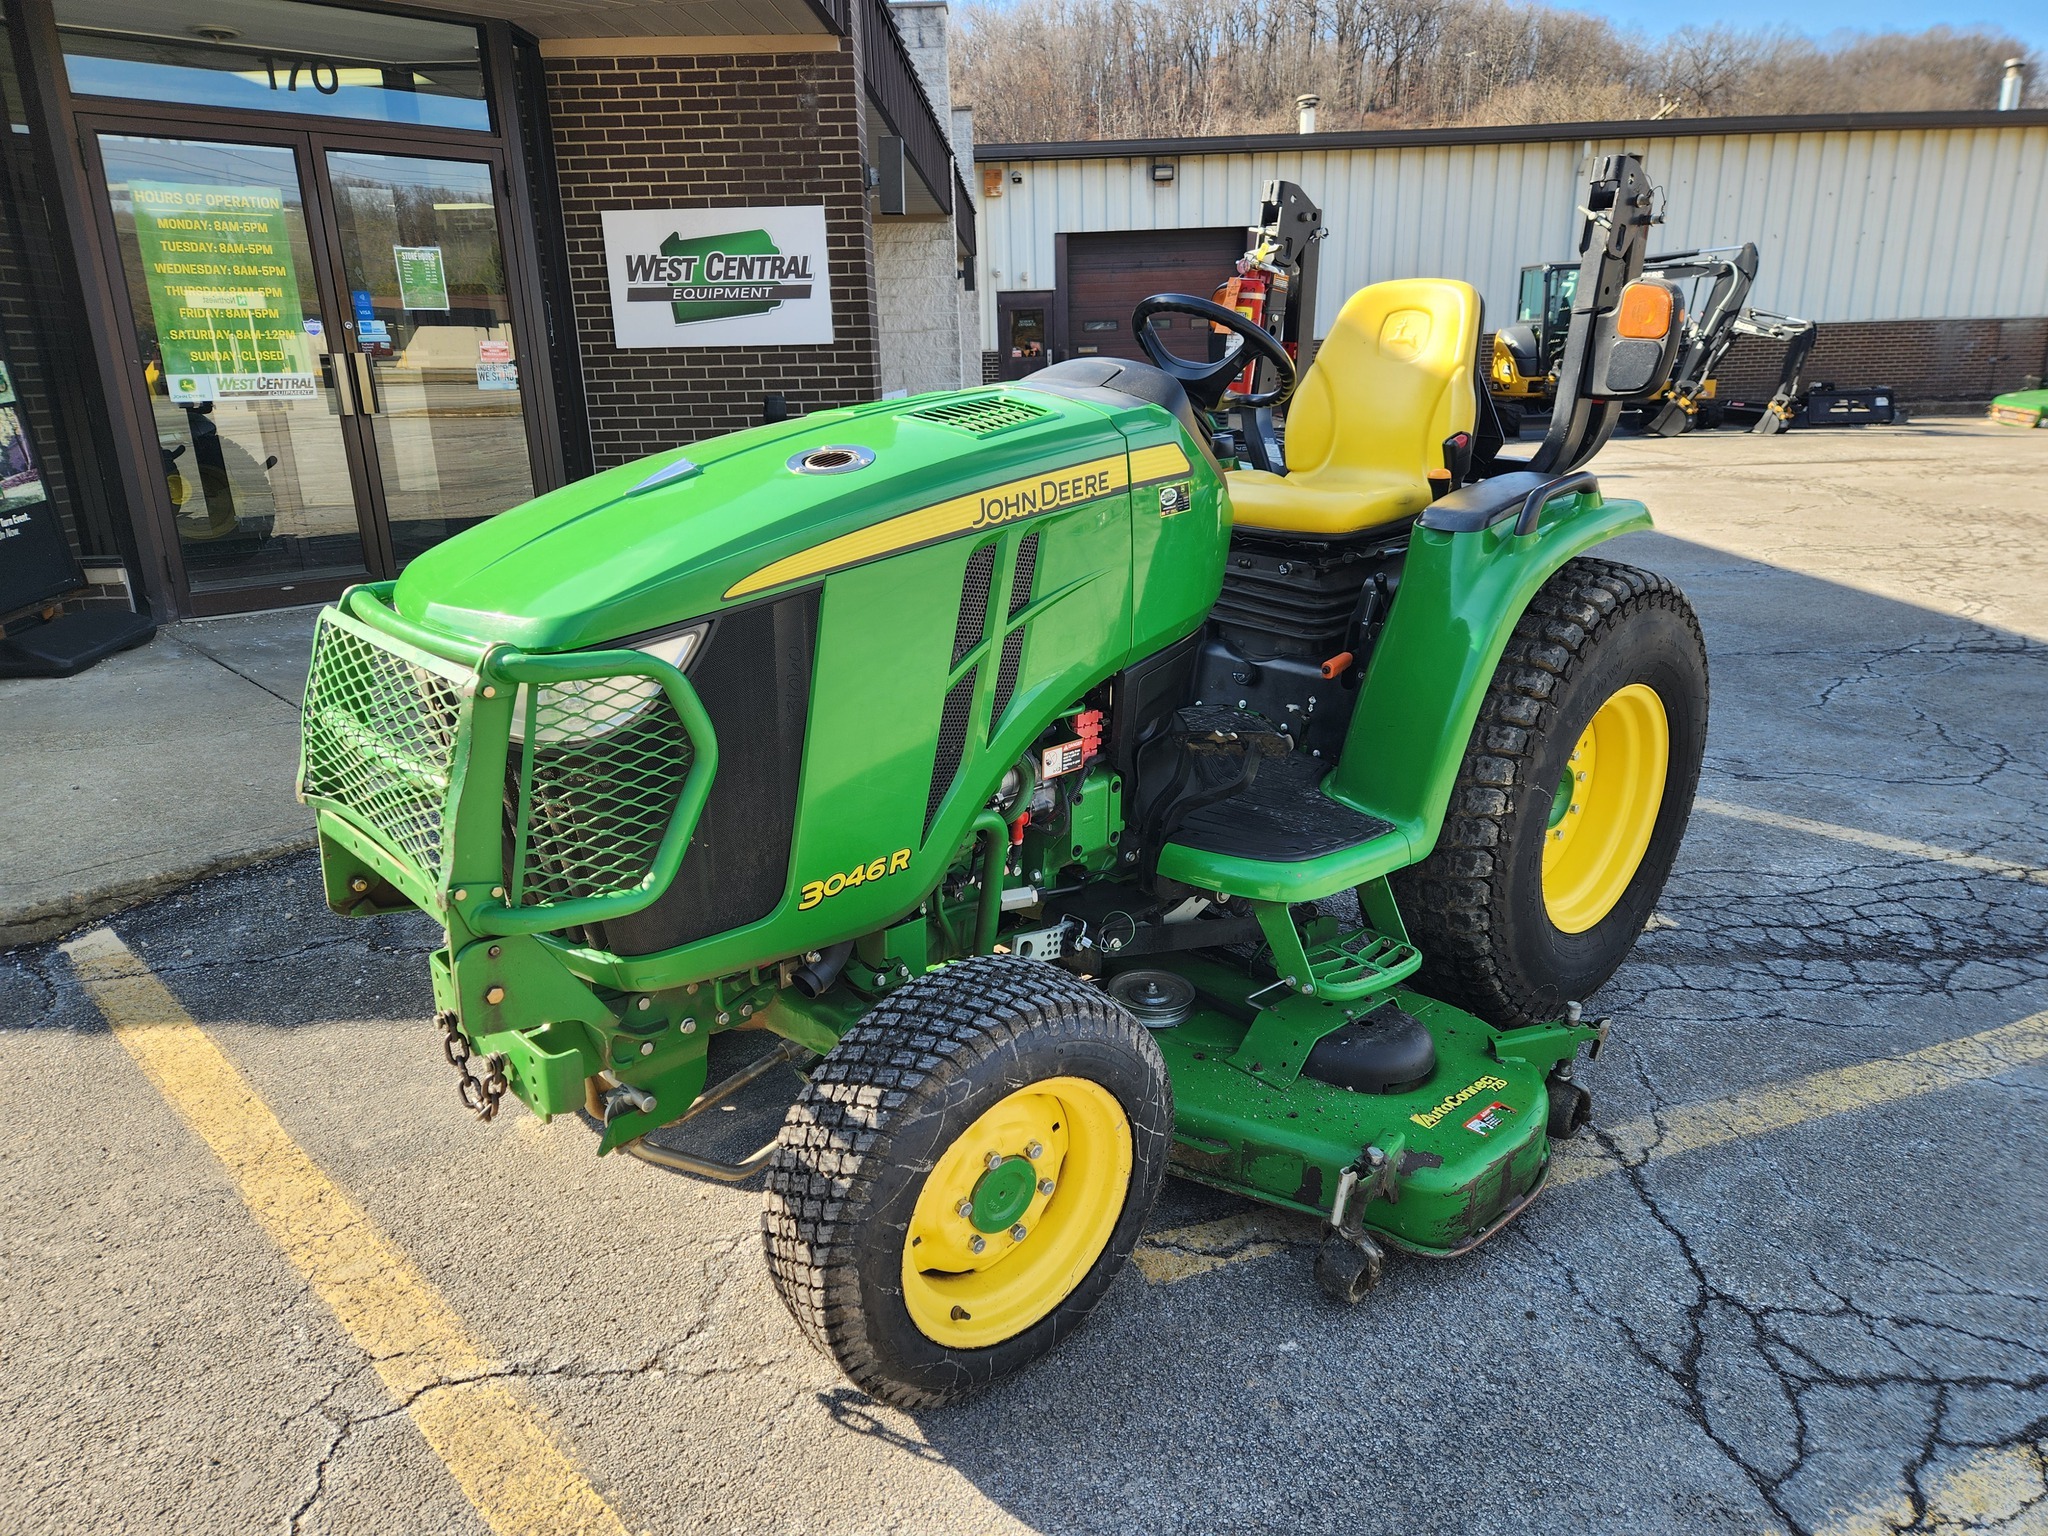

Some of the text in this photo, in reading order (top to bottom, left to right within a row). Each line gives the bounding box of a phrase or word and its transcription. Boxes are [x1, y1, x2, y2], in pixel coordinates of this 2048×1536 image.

[258, 56, 339, 94] 170
[133, 190, 280, 209] HOURS OF OPERATION
[157, 218, 268, 233] MONDAY: 8AM-5PM
[160, 240, 273, 255] TUESDAY: 8AM-5PM
[154, 263, 286, 277] WEDNESDAY: 8AM-5PM
[625, 252, 813, 282] WEST CENTRAL
[672, 286, 773, 299] EQUIPMENT
[179, 307, 279, 319] FRIDAY: 8AM-5PM
[169, 330, 296, 340] SATURDAY: 8AM-12PM
[478, 372, 490, 381] WE
[972, 471, 1110, 526] JOHN DEERE
[1419, 1075, 1499, 1126] AutoConnect
